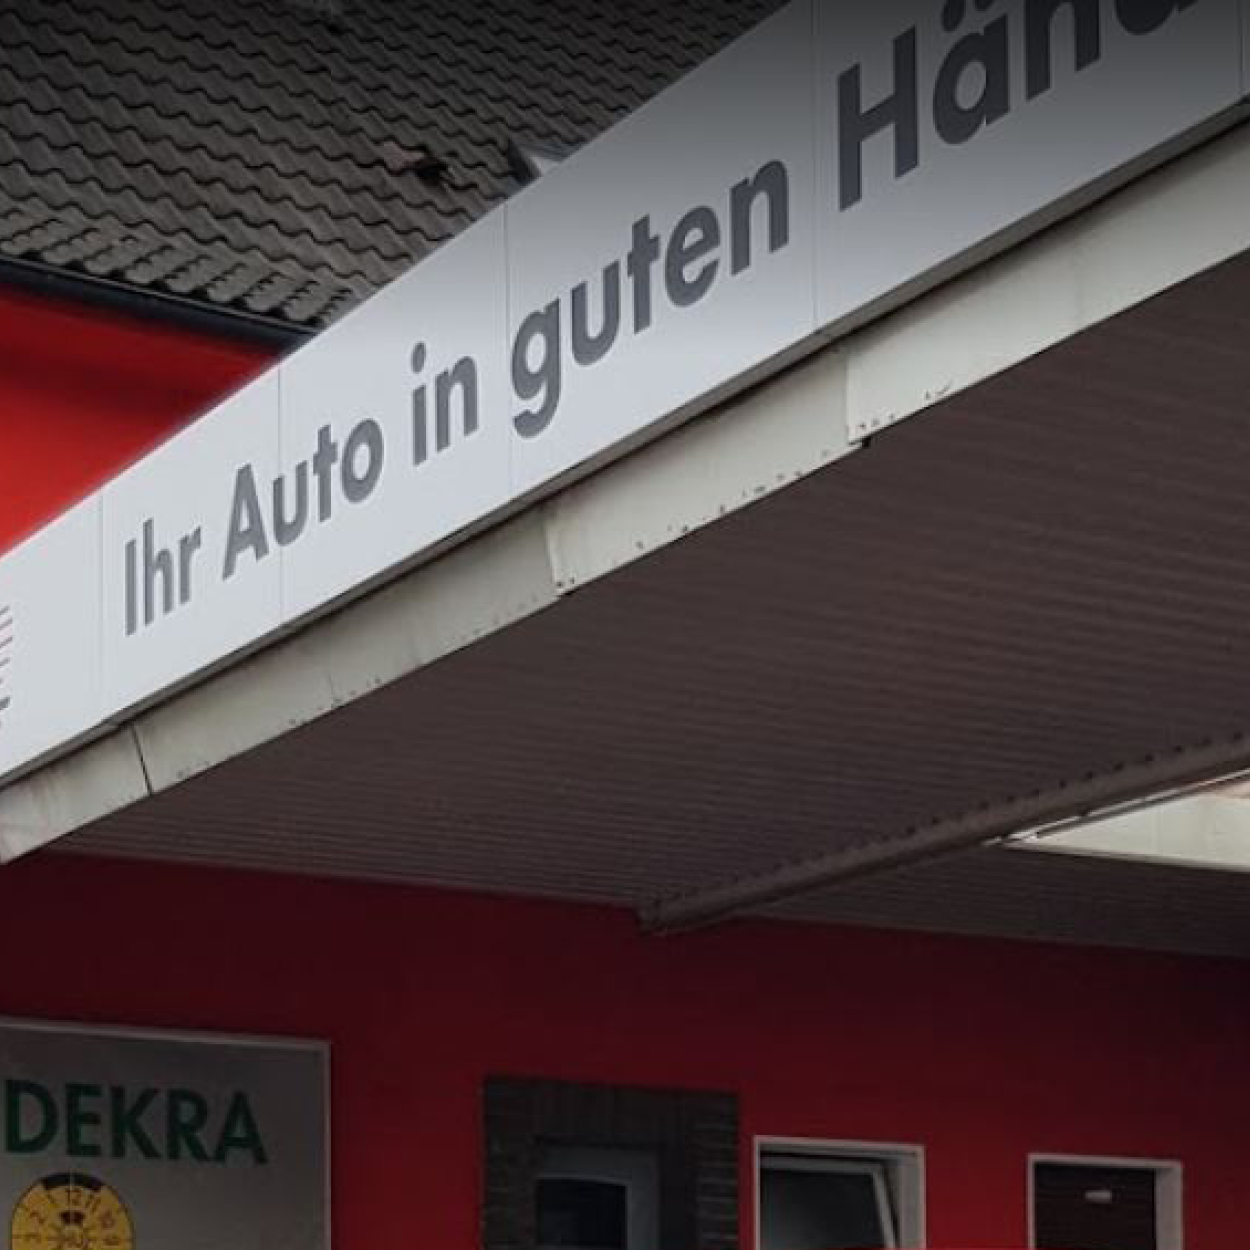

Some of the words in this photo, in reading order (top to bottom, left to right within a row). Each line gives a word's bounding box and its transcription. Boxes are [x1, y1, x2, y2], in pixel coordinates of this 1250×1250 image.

[124, 516, 202, 636] Ihr
[222, 417, 384, 580] Auto
[411, 341, 479, 466] in
[511, 159, 790, 439] guten
[4, 1079, 269, 1165] DEKRA
